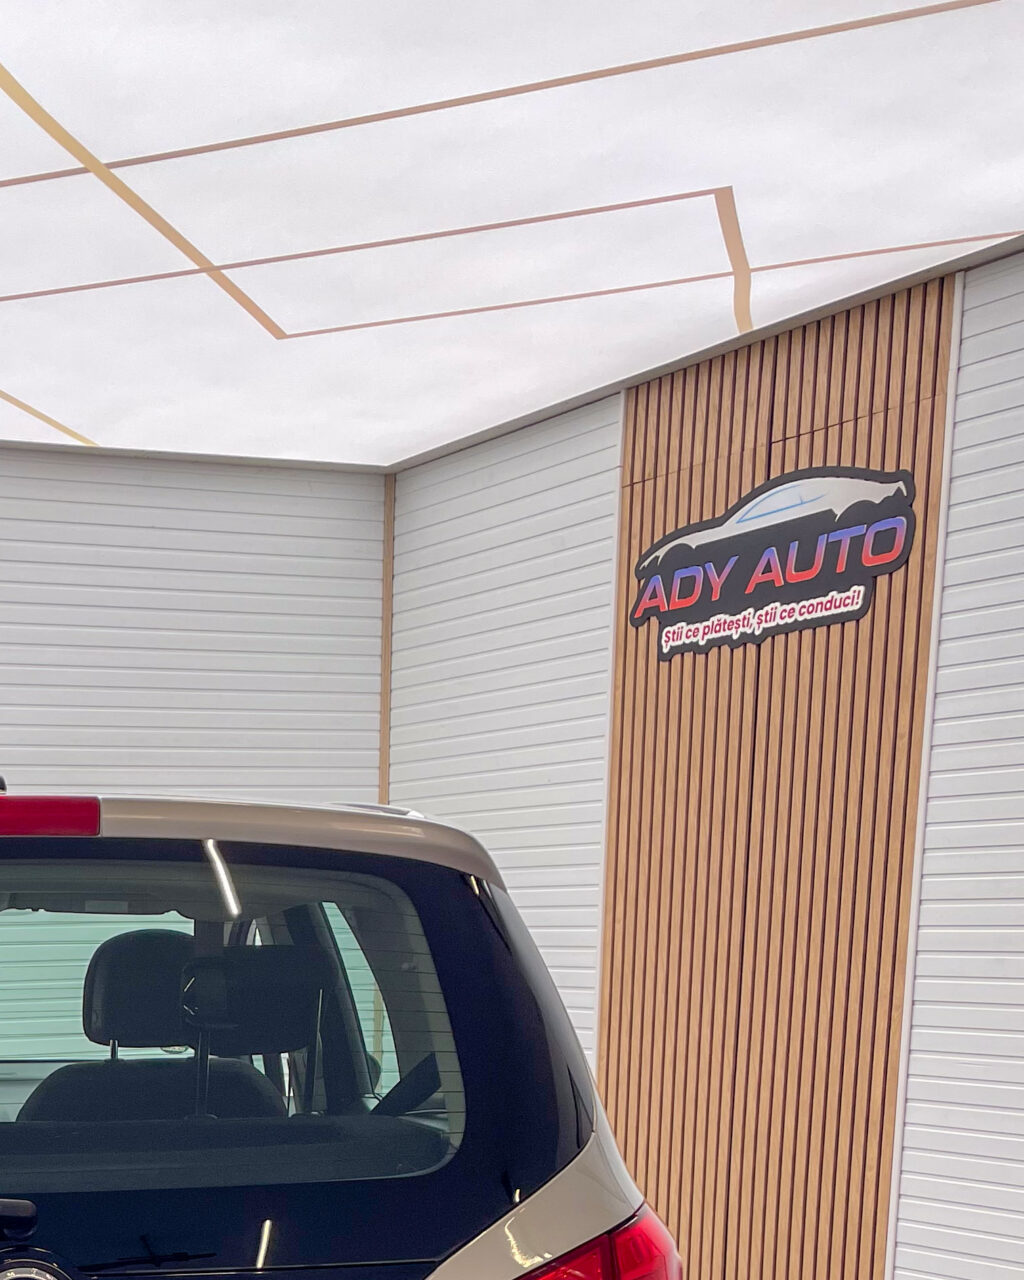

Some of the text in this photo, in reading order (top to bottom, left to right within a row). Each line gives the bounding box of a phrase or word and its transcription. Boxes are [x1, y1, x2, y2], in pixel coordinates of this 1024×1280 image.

[633, 516, 907, 619] ADY AUTO
[685, 624, 700, 639] ce
[779, 604, 796, 619] ce
[798, 590, 862, 616] conduci!
